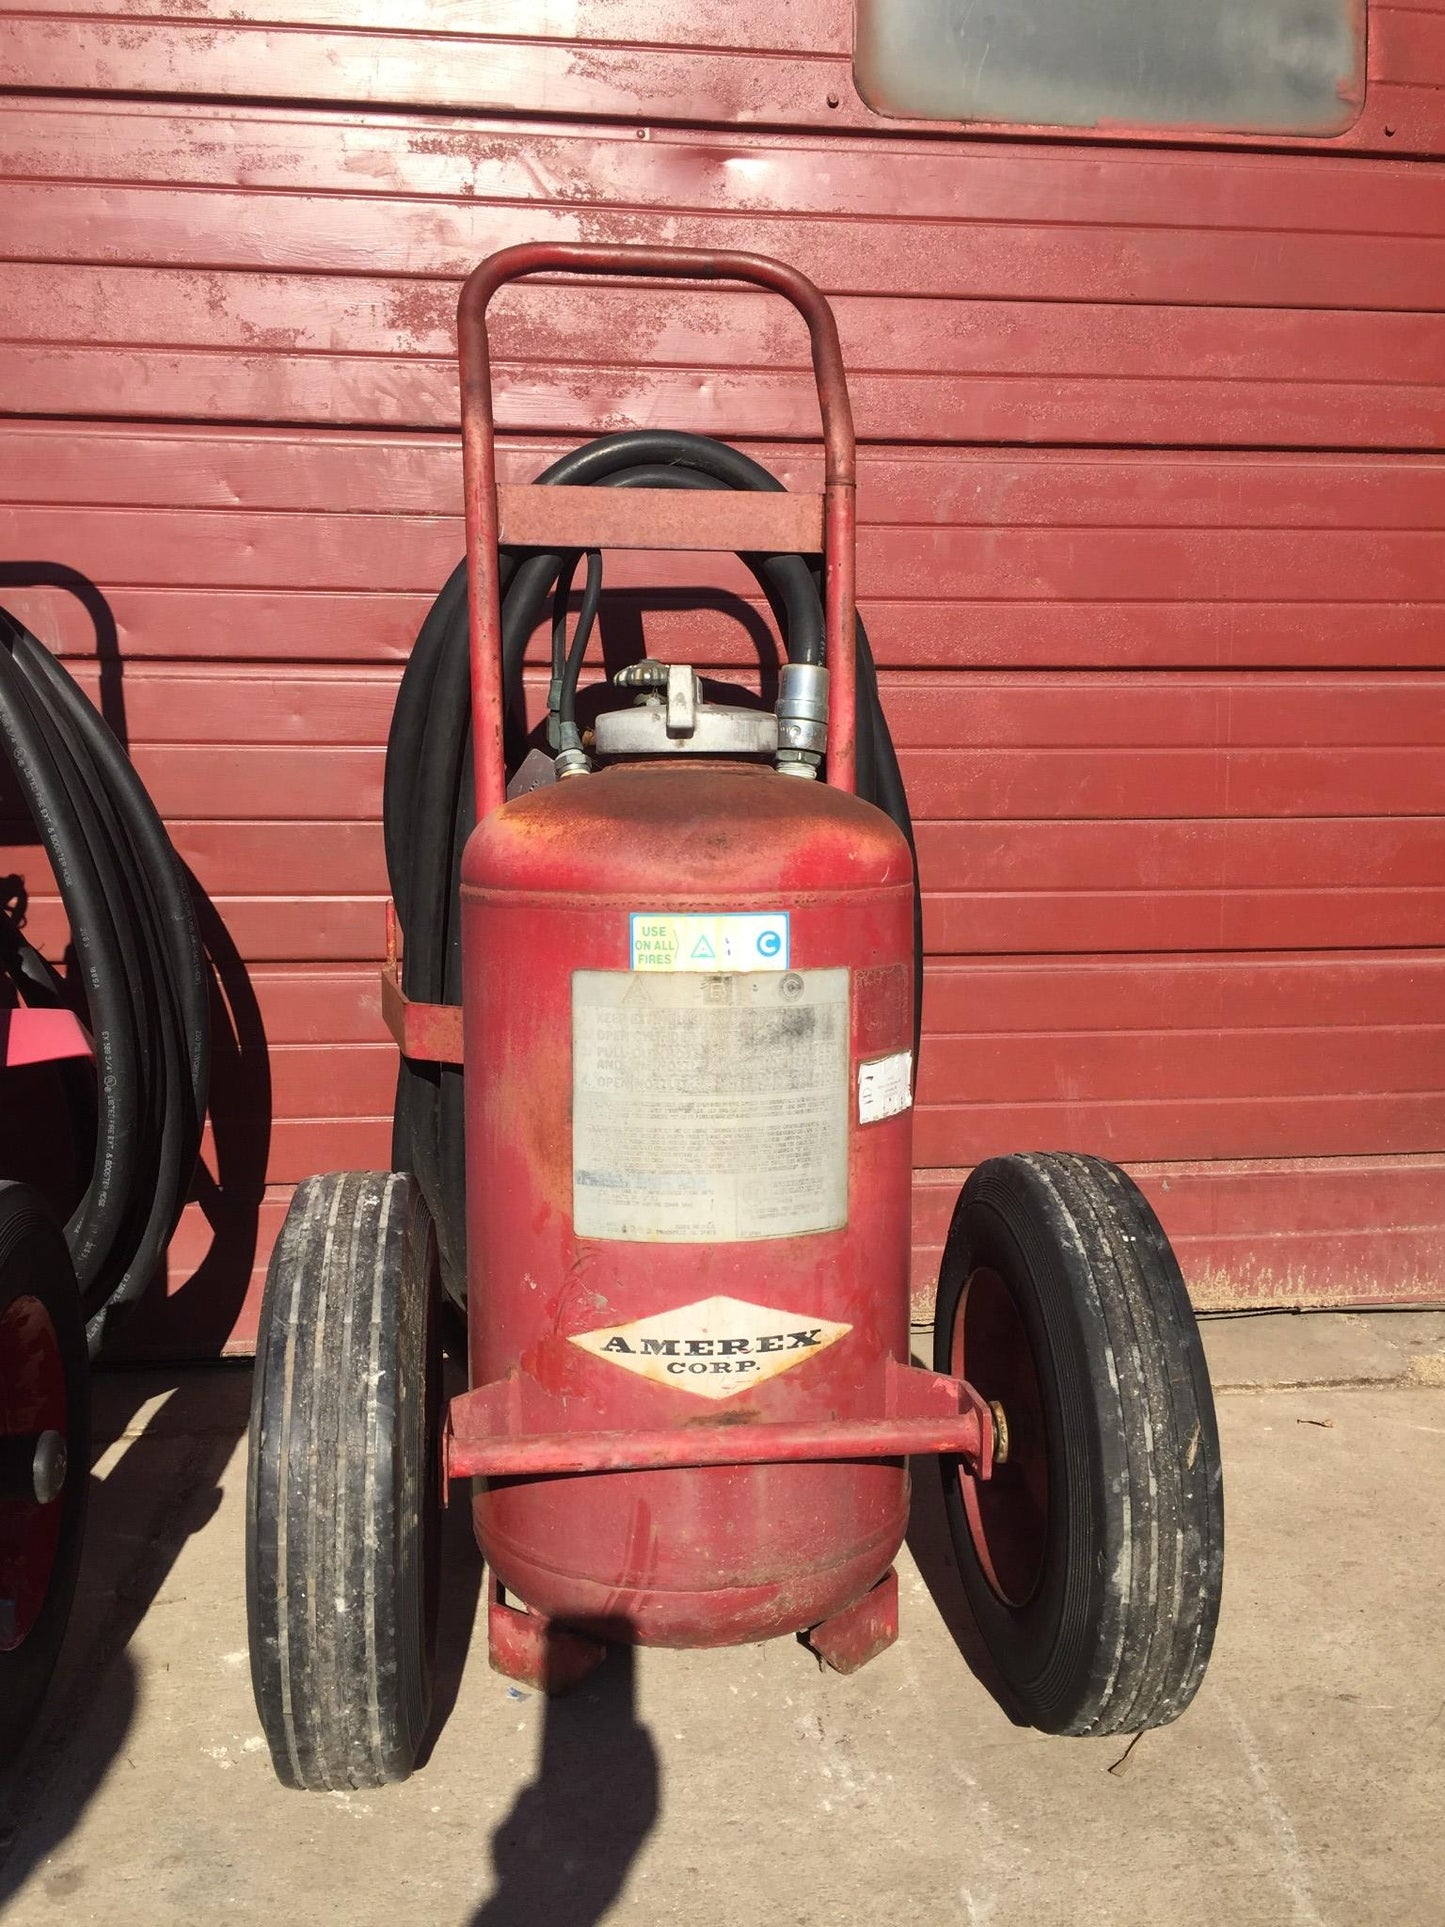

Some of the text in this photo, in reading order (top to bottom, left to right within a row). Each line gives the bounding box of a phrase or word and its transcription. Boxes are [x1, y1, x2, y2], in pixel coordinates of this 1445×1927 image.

[642, 926, 667, 937] USE
[635, 940, 675, 951] ON ALL
[638, 954, 672, 965] FIRES
[600, 1329, 822, 1356] AMEREX
[666, 1360, 761, 1374] CORP.
